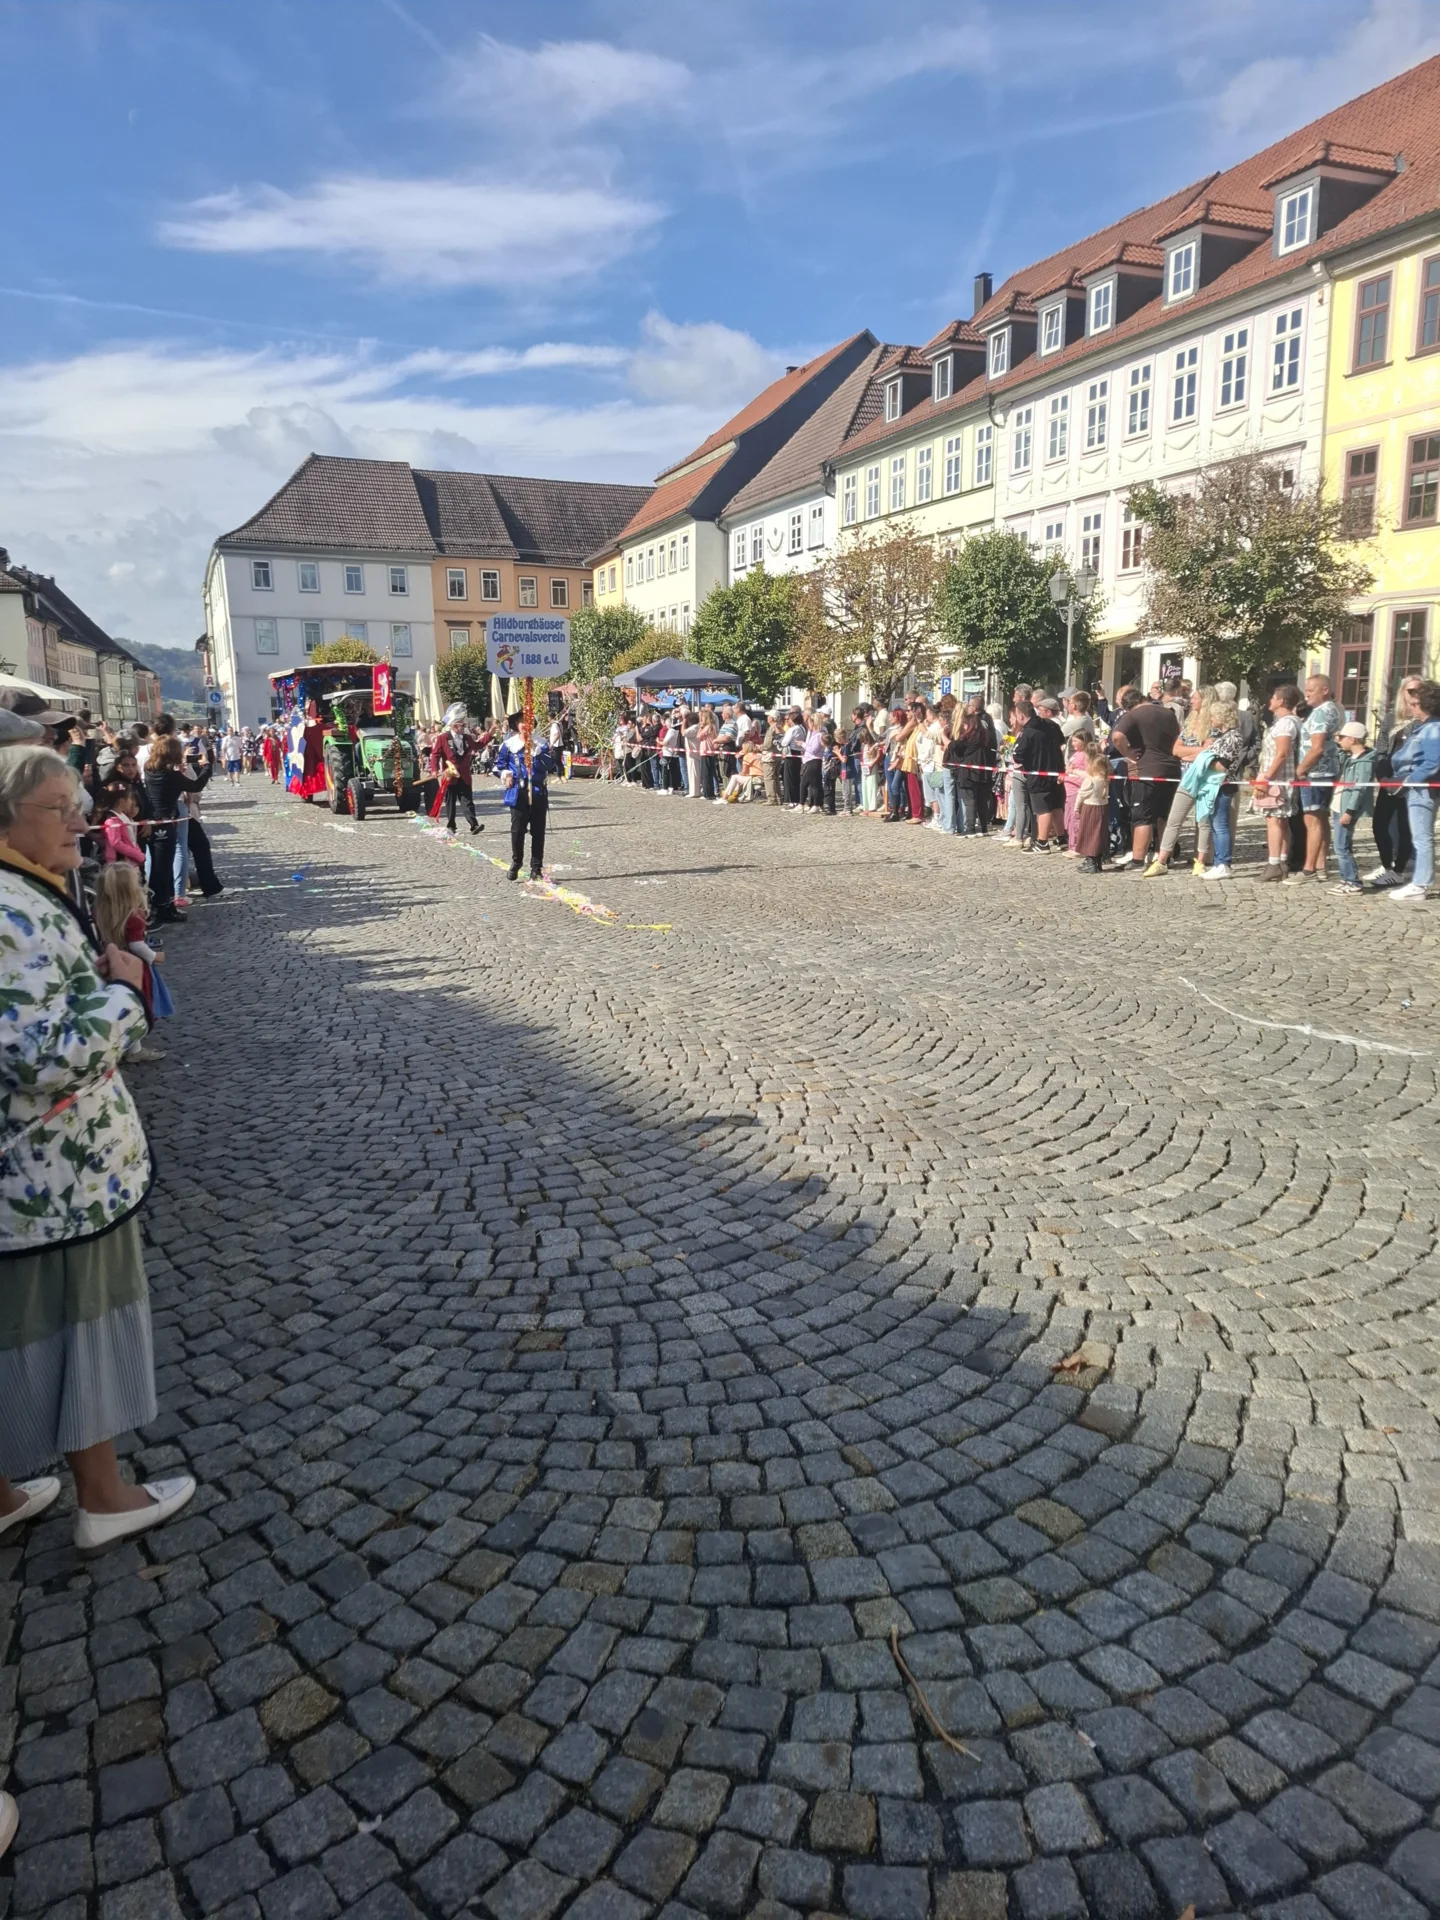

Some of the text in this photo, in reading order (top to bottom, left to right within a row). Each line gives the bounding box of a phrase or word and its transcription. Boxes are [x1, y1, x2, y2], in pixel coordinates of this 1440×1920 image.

[493, 617, 564, 630] Hildburghäuser
[492, 631, 566, 643] Carnevalsverein
[521, 653, 541, 665] 1888
[943, 679, 950, 693] P
